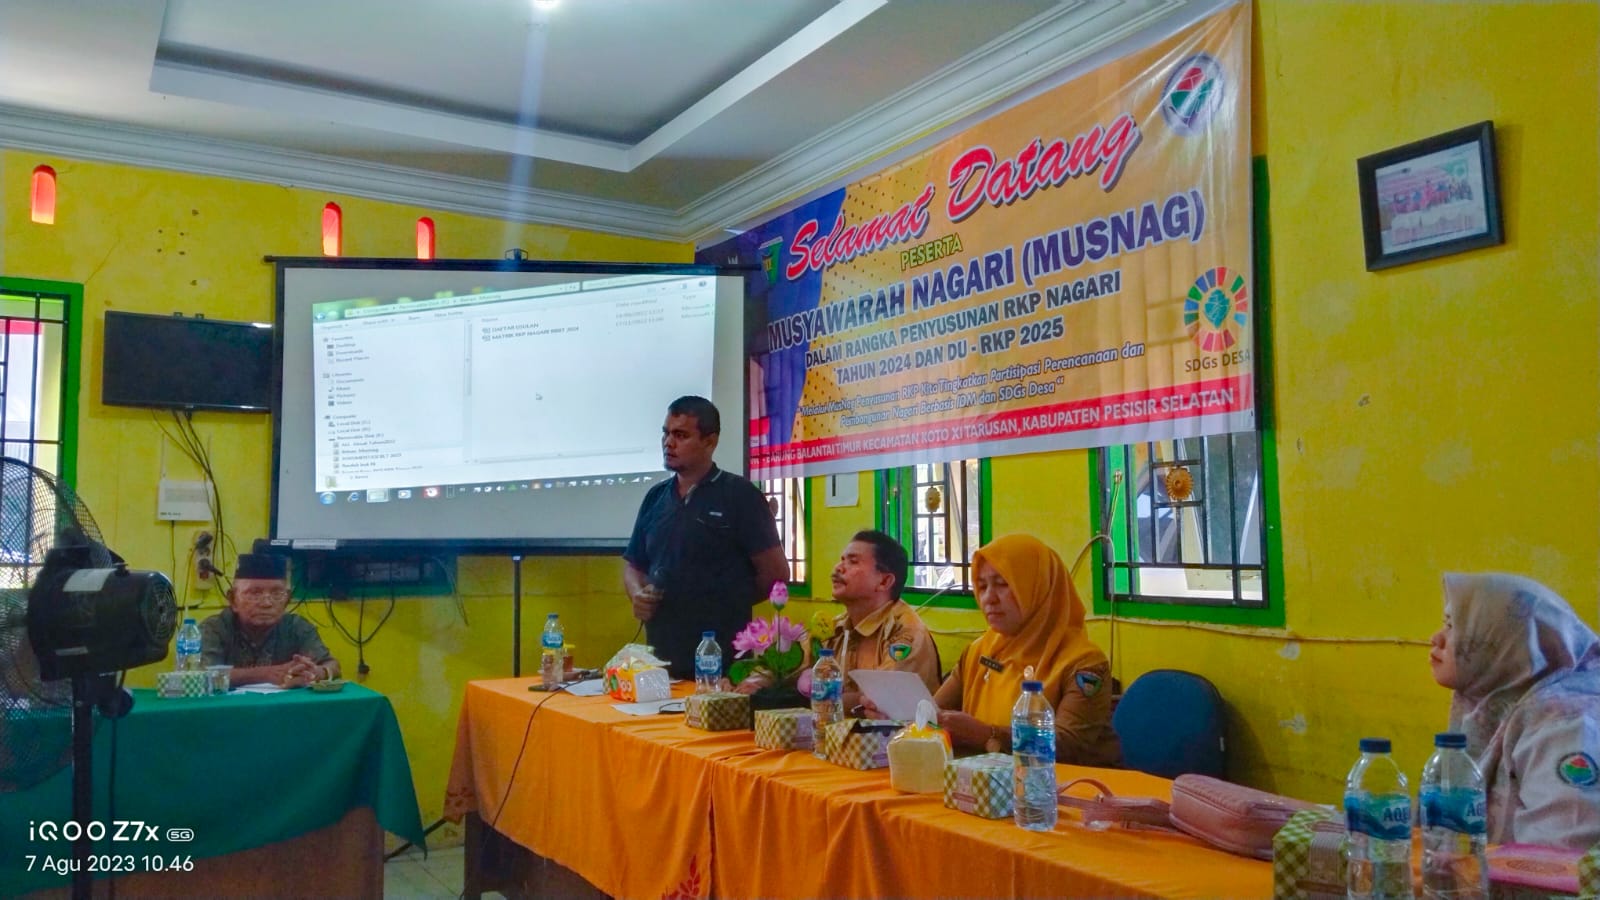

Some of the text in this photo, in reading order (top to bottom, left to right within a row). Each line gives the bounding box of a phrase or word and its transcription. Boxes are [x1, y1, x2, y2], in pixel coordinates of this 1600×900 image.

[786, 112, 1141, 280] Selamat Datang
[768, 189, 1205, 353] MUSYAWARAH NAGARI (MUSNAG)
[901, 233, 963, 271] PESERTA
[805, 270, 1121, 369] DALAM RANGKA PENYUSUNAN RKP NAGARI
[836, 361, 876, 386] TAHUN
[879, 355, 912, 377] 2024
[915, 345, 944, 369] DAN
[947, 339, 968, 361] DU
[980, 331, 1016, 355] RKP
[1020, 317, 1065, 346] 2025
[902, 383, 919, 399] RKP
[920, 382, 938, 396] Kita
[938, 373, 988, 394] Tingkatkan
[990, 359, 1041, 384] Partisipasi
[1044, 348, 1118, 374] Perencanaan
[1121, 341, 1145, 359] dan
[1185, 350, 1250, 372] SDGs DESA
[797, 443, 835, 460] BALANTAI
[835, 439, 862, 455] TIMUR
[863, 431, 919, 452] KECAMATAN
[921, 426, 949, 444] KOTO
[952, 425, 963, 439] XI
[965, 418, 1021, 436] TARUSAN,
[1022, 406, 1101, 431] KABUPATEN
[1103, 398, 1158, 421] PESISIR
[1161, 387, 1234, 413] SELATAN
[920, 397, 954, 415] Berbasis
[956, 391, 977, 408] IDM
[978, 389, 997, 405] dan
[999, 383, 1026, 402] SDGs
